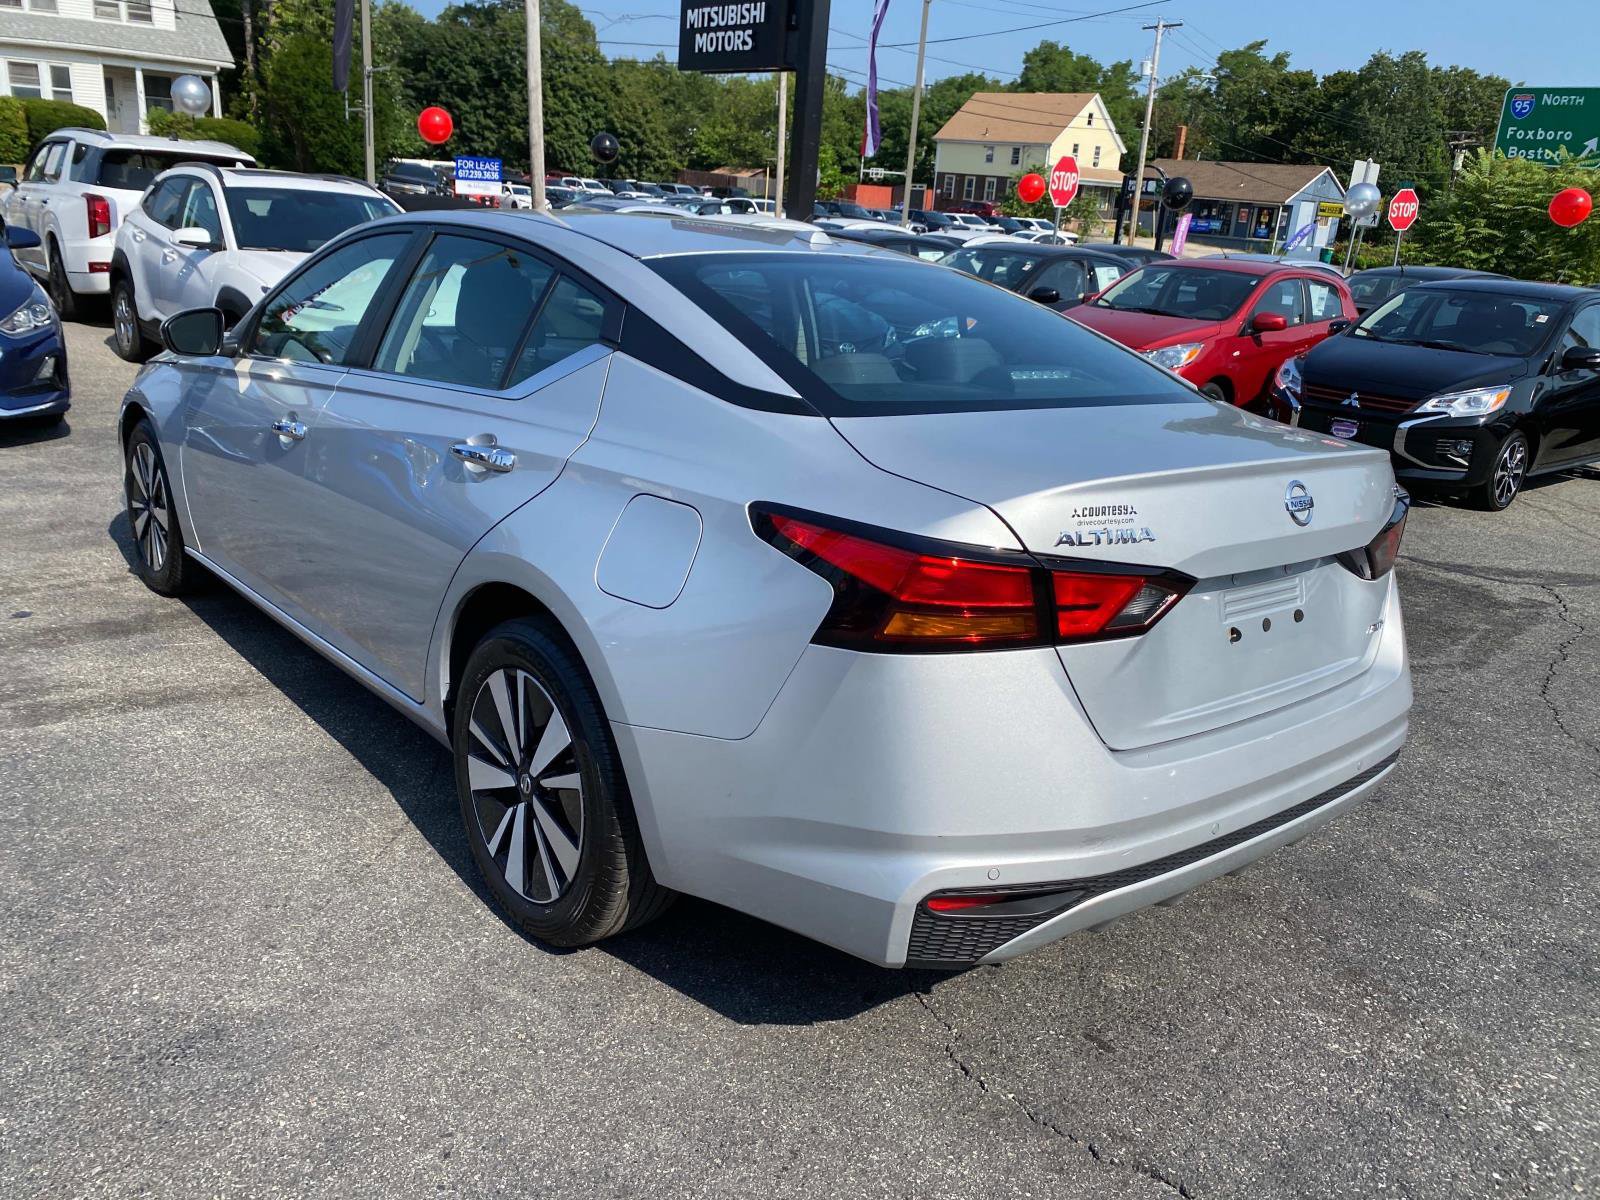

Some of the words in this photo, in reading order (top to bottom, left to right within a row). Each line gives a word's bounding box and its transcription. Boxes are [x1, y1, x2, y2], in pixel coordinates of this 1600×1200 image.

[686, 1, 766, 29] MITSUBISHI
[694, 29, 753, 53] MOTORS
[1515, 101, 1530, 113] 95
[1541, 93, 1585, 106] NORTH
[1506, 126, 1573, 140] Foxboro
[457, 159, 475, 170] FOR
[475, 160, 500, 171] LEASE
[1051, 171, 1078, 191] STOP
[1390, 202, 1417, 218] STOP
[1076, 518, 1135, 527] drivecourtesy.com
[1053, 527, 1157, 547] ALTIMA
